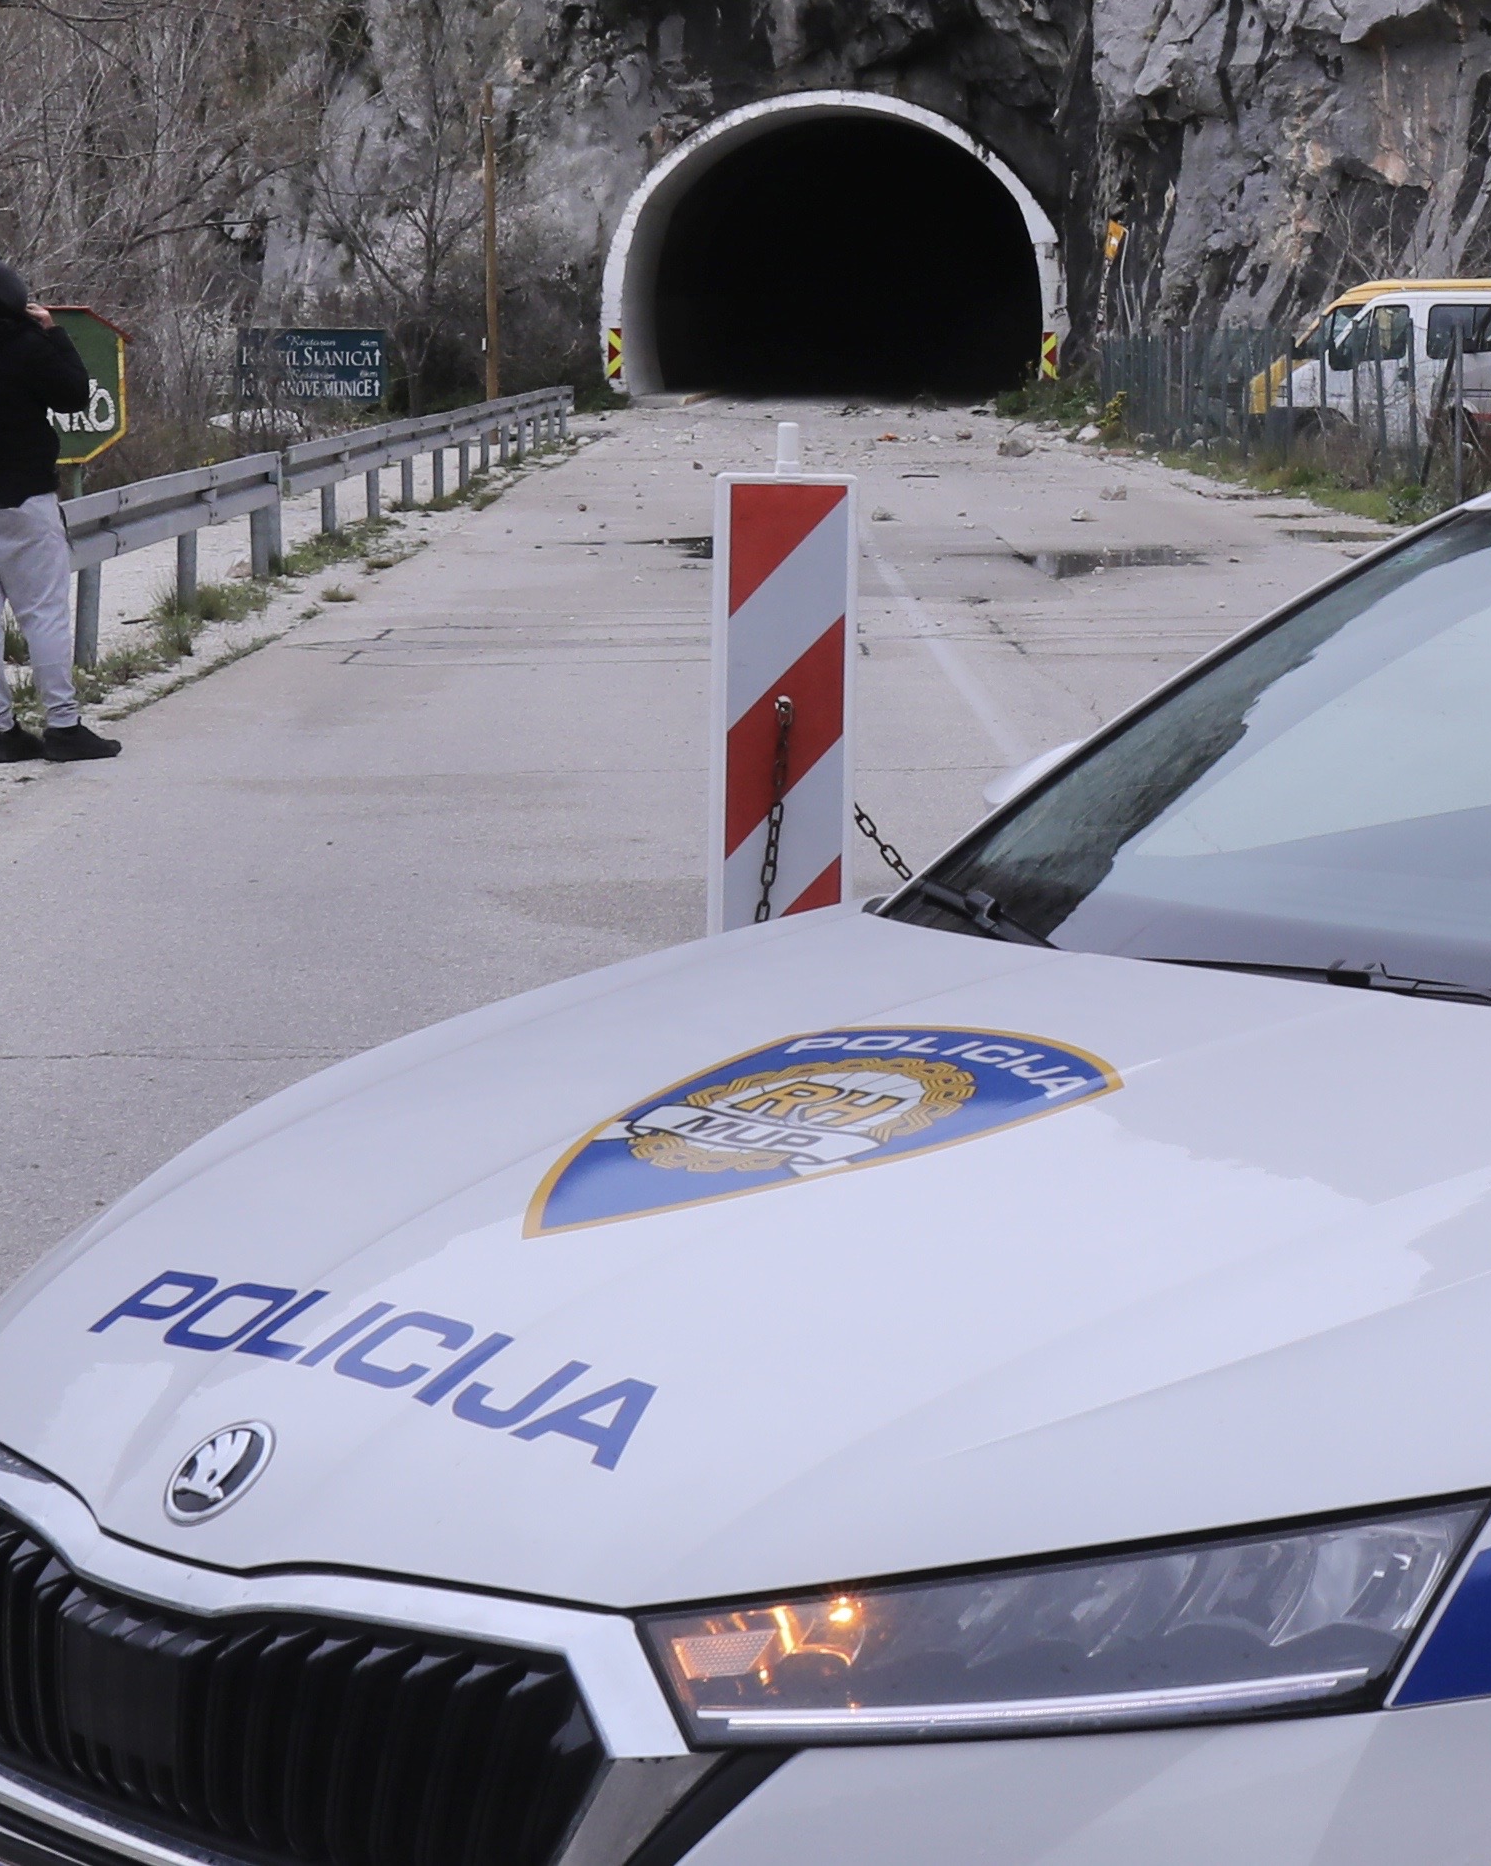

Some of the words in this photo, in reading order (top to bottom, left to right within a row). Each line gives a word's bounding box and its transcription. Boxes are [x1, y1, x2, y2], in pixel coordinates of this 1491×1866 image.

[784, 1036, 1088, 1099] POLICIJA
[726, 1080, 906, 1128] RH
[673, 1115, 822, 1149] MUP
[87, 1269, 659, 1472] POLICIJA
